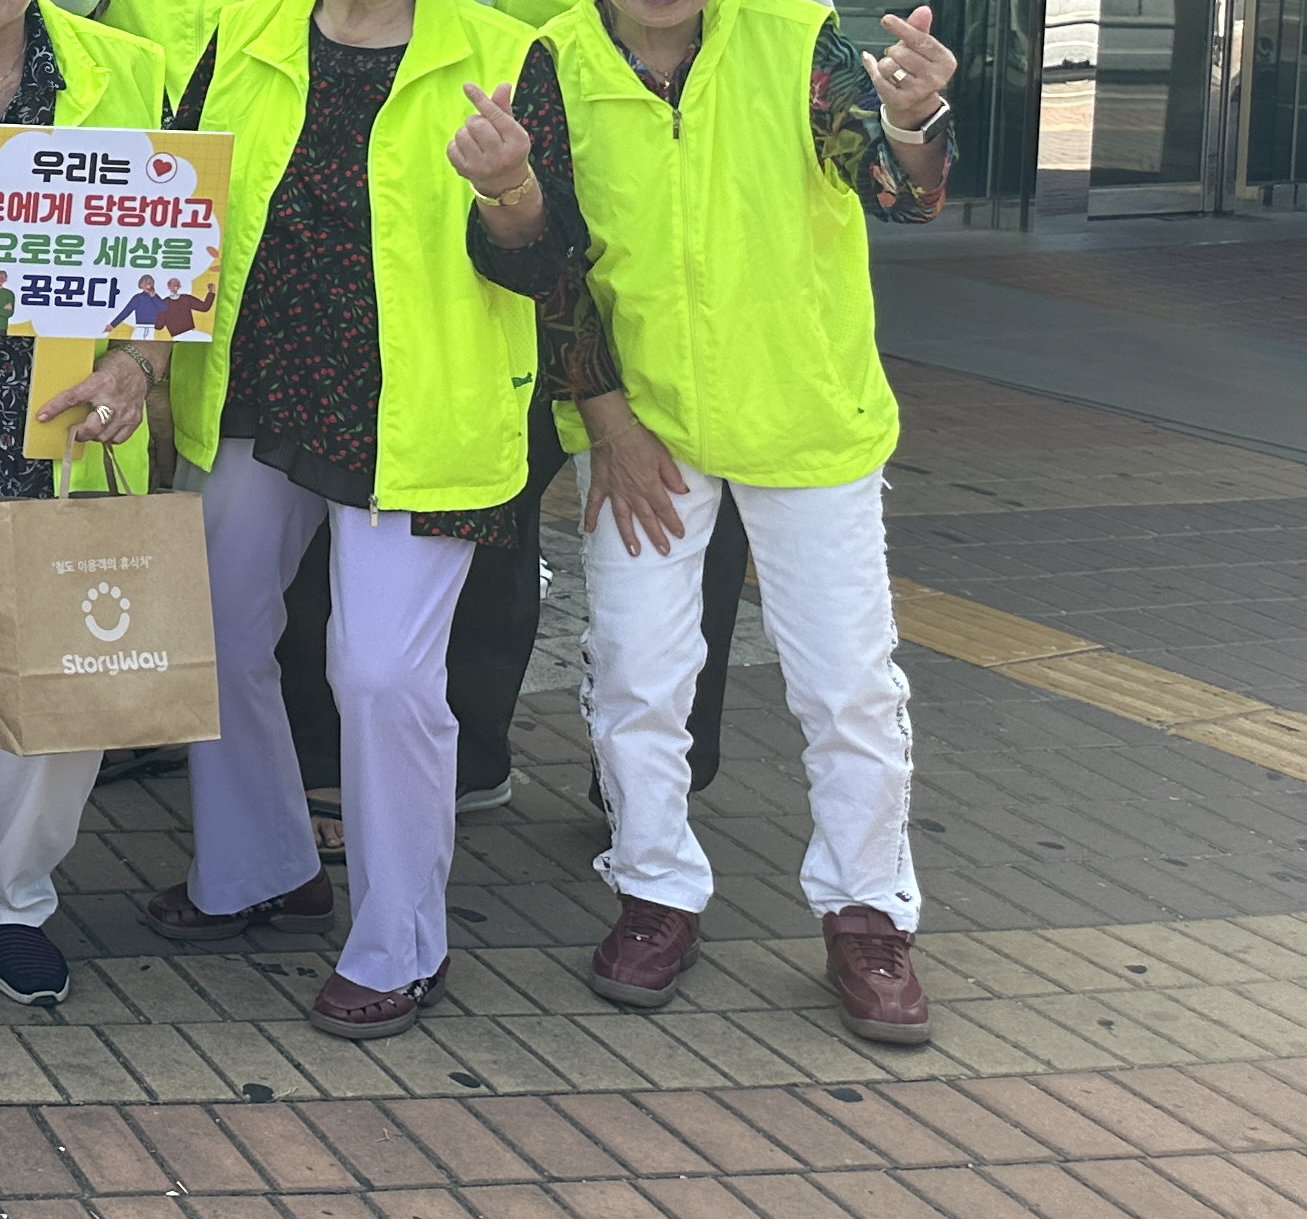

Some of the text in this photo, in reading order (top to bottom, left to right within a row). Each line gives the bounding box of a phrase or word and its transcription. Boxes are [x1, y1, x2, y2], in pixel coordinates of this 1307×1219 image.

[31, 150, 131, 185] 우리는
[84, 194, 213, 229] 당당하고
[93, 235, 193, 270] 세상을
[20, 274, 121, 309] 꿈꾼다
[77, 558, 117, 573] 이용객의
[61, 649, 170, 676] StoryWay
